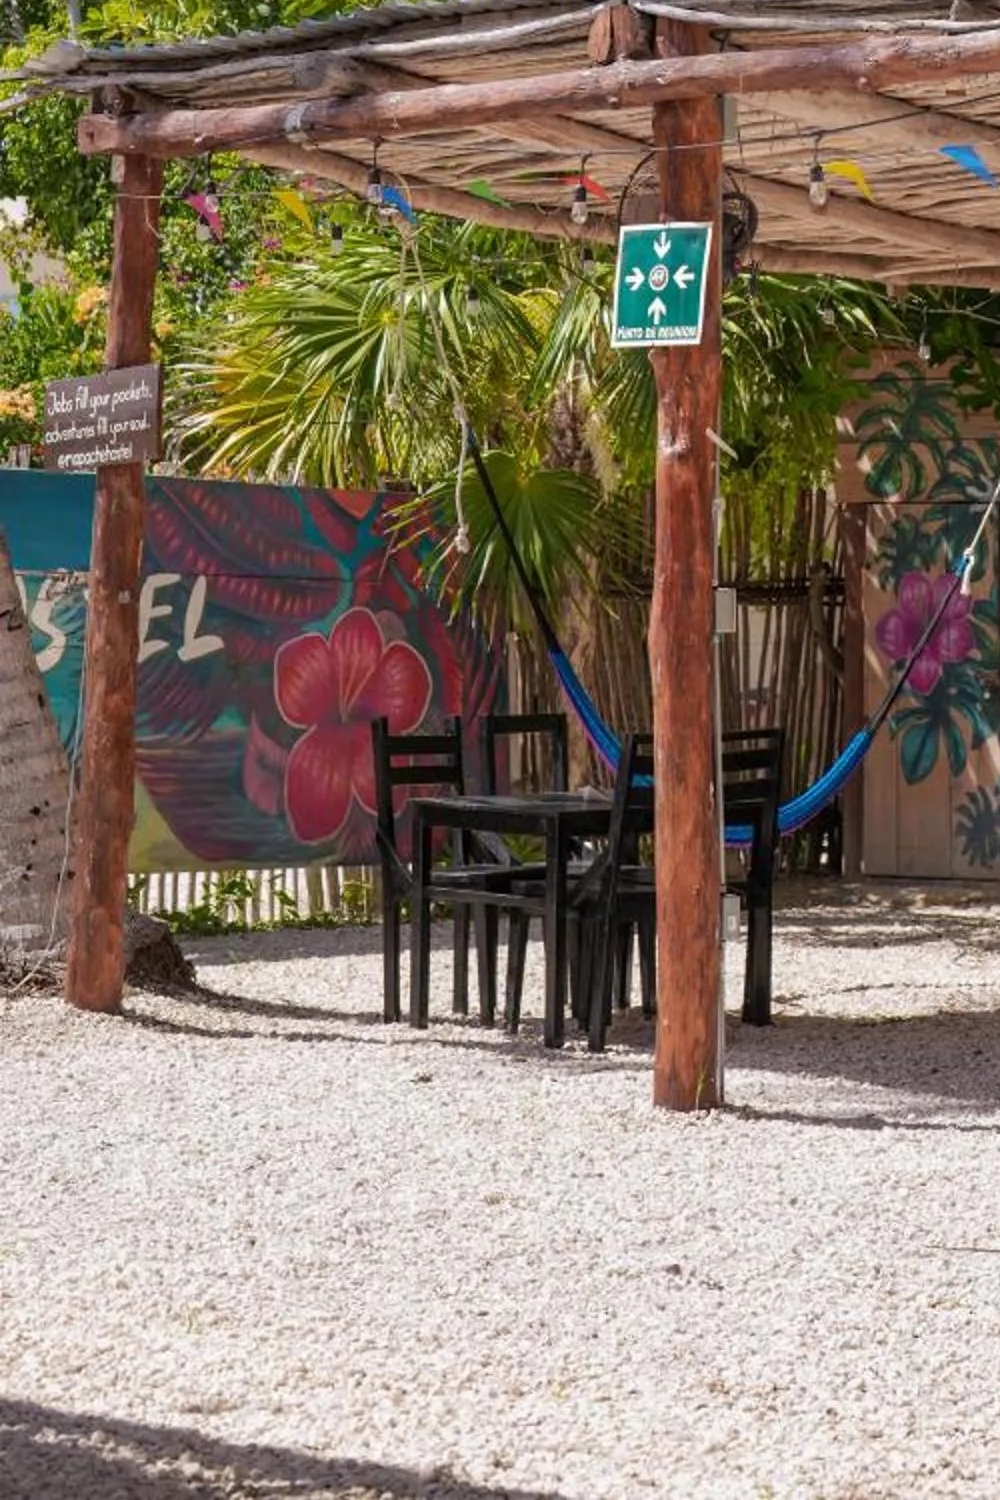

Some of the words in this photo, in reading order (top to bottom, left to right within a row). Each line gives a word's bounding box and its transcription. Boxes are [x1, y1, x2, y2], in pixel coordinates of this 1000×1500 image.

[47, 391, 73, 416] Jobs
[75, 385, 89, 411] fill
[89, 393, 111, 418] your
[45, 420, 95, 443] adventures
[97, 416, 109, 437] fill
[110, 421, 129, 445] your
